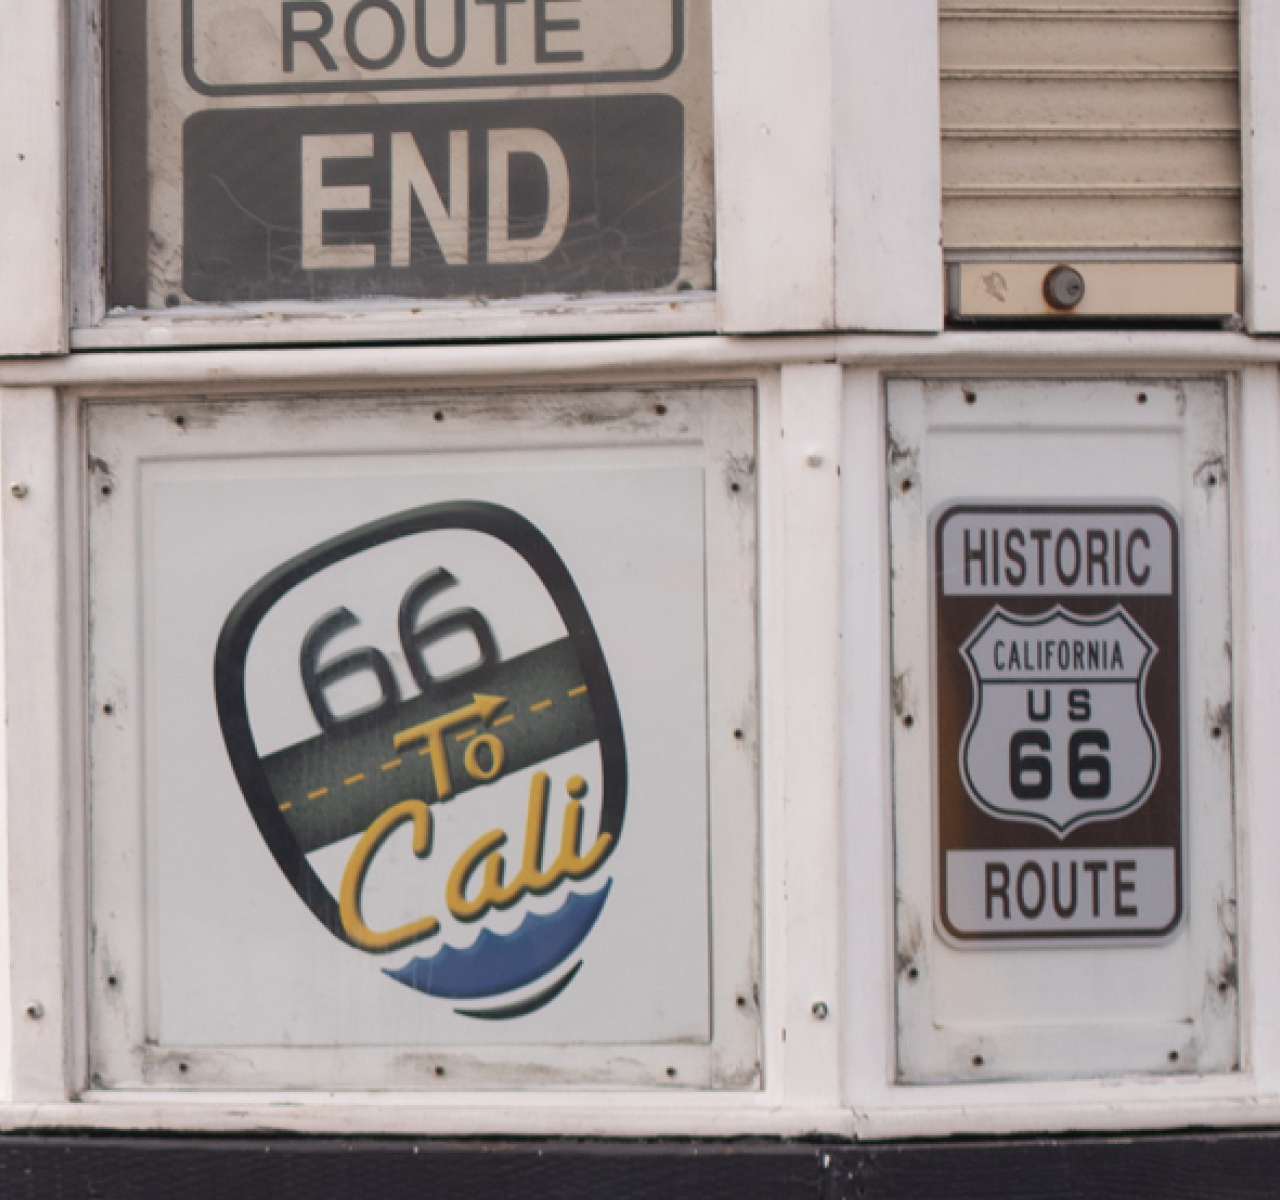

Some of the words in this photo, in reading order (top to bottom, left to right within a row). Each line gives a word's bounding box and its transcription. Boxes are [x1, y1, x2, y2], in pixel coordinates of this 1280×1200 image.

[300, 127, 571, 270] END
[962, 527, 1152, 587] HISTORIC
[299, 565, 502, 735] 66
[993, 640, 1125, 671] CALIFORNIA
[1008, 729, 1112, 801] 66
[339, 771, 614, 955] Cali
[984, 860, 1138, 920] ROUTE
